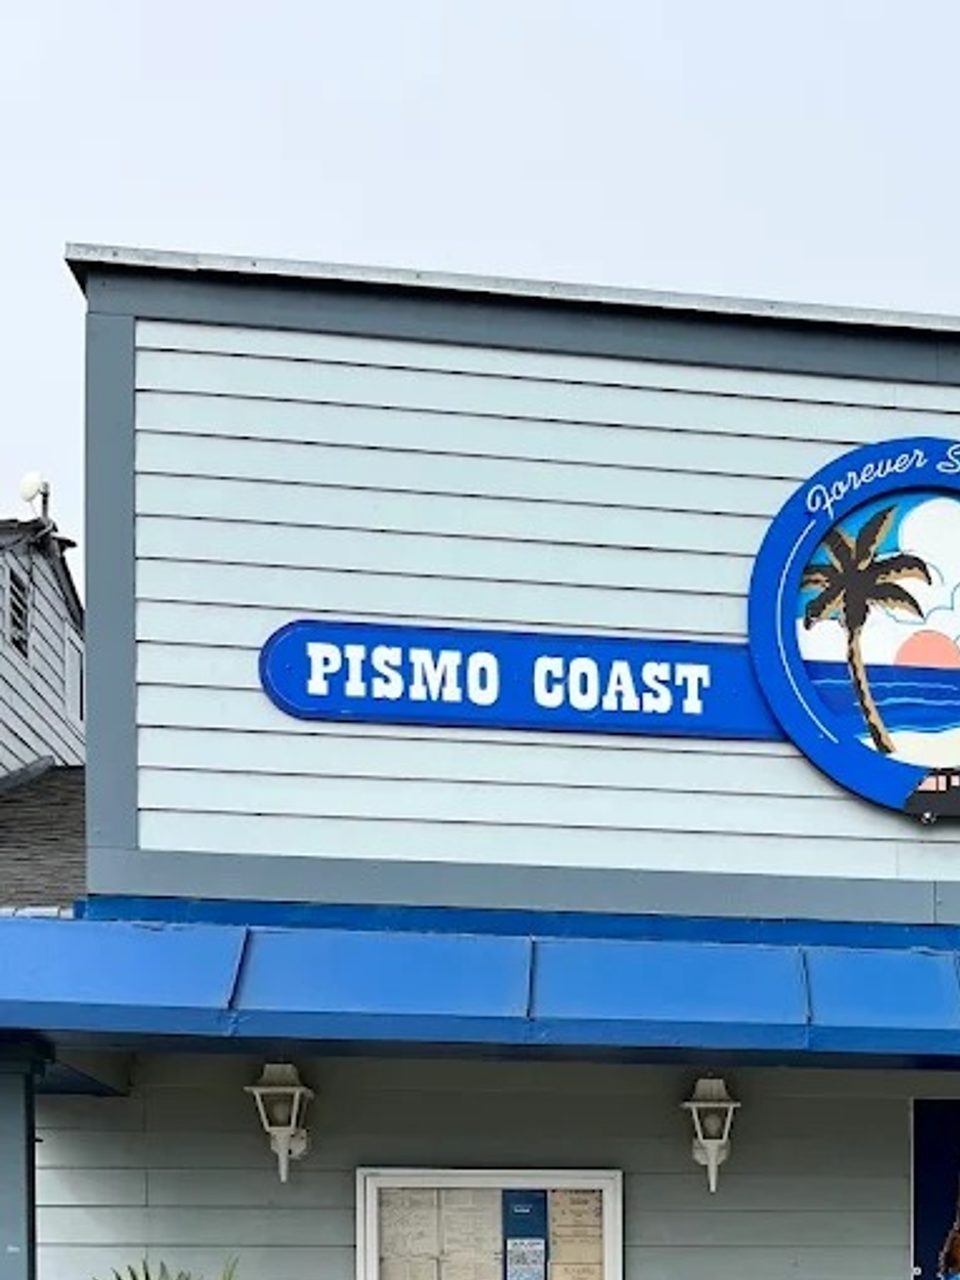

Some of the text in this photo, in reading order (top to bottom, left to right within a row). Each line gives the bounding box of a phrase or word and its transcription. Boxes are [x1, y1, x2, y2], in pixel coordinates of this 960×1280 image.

[805, 448, 928, 519] Forever
[306, 642, 710, 714] PISMO COAST
